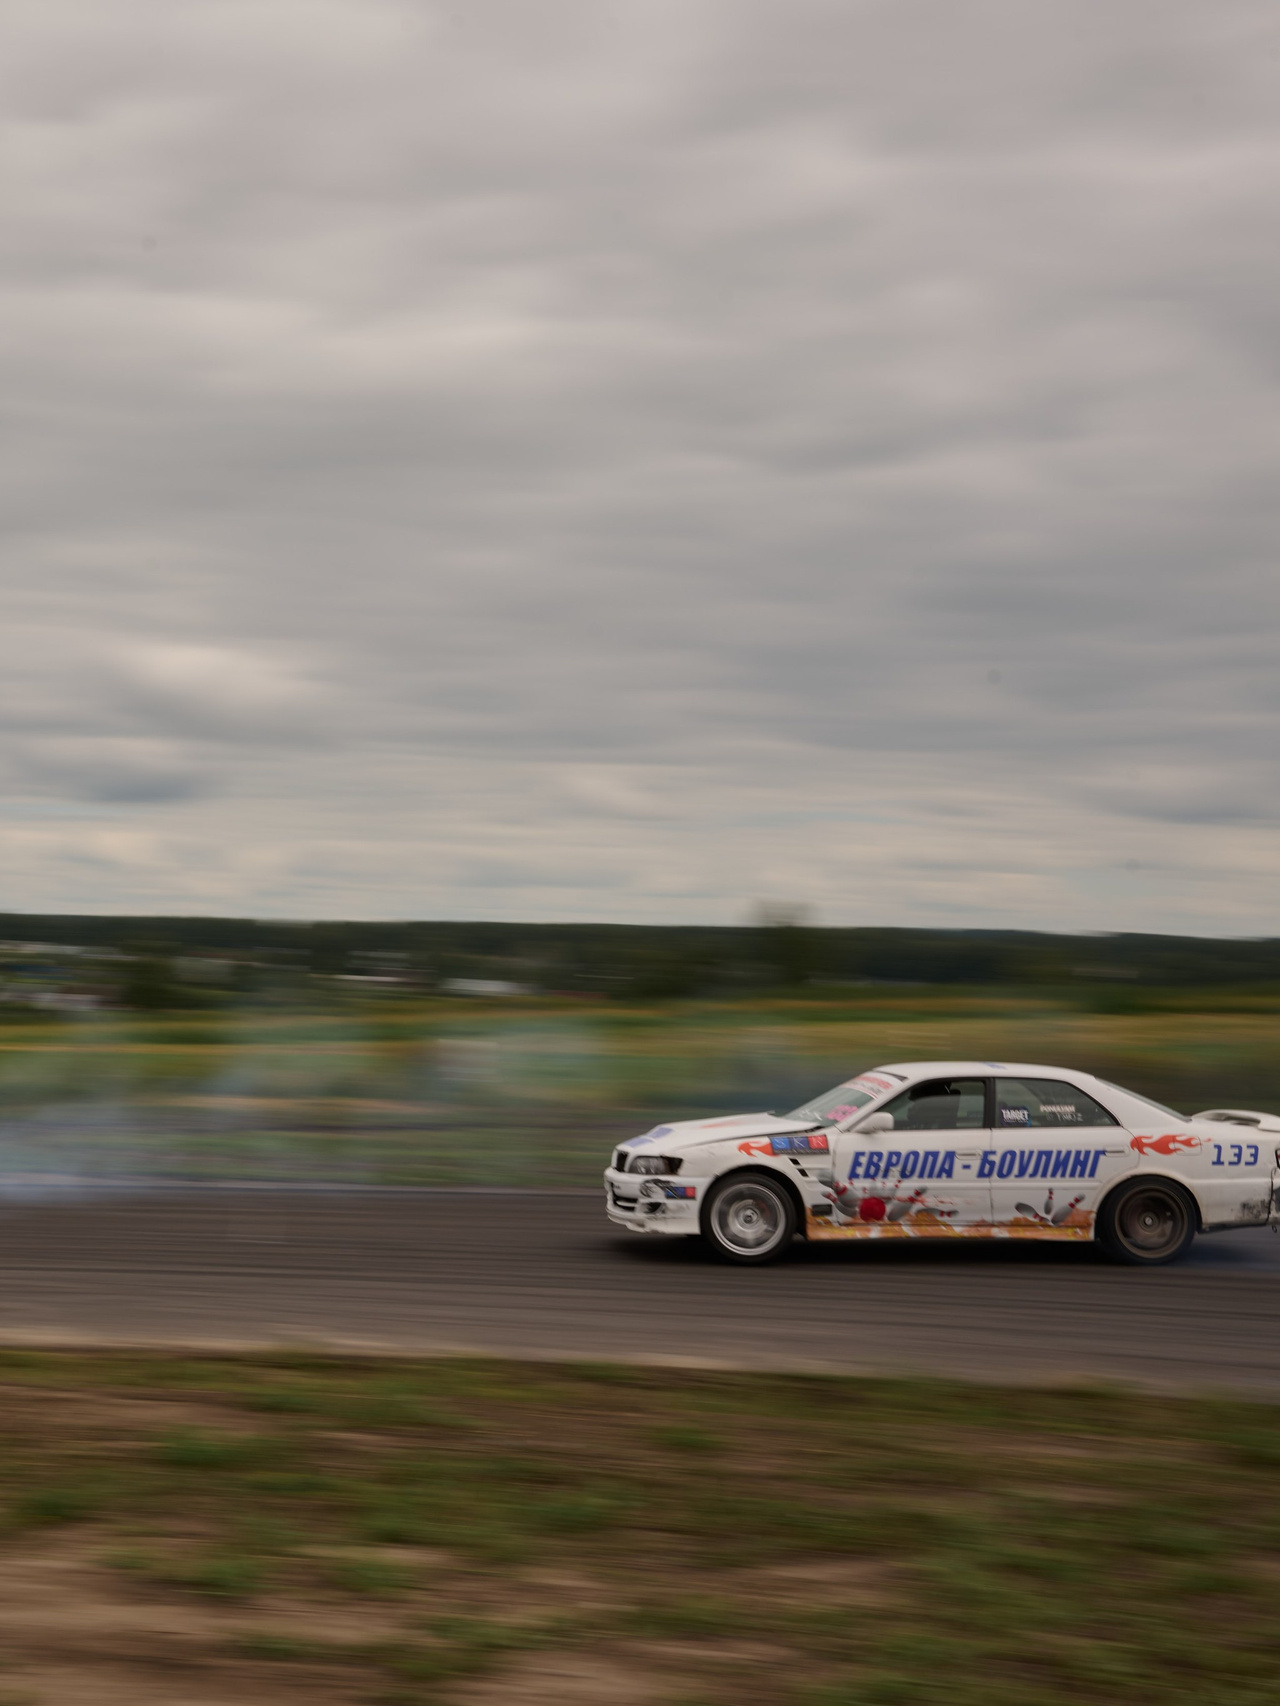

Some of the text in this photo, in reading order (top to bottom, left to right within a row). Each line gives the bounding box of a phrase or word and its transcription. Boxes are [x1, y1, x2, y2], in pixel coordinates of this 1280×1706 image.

[1001, 1109, 1028, 1121] TARGET
[848, 1151, 956, 1180] ЕВРОПА
[976, 1150, 1106, 1179] БОУЛИНГ
[1211, 1144, 1260, 1166] 133
